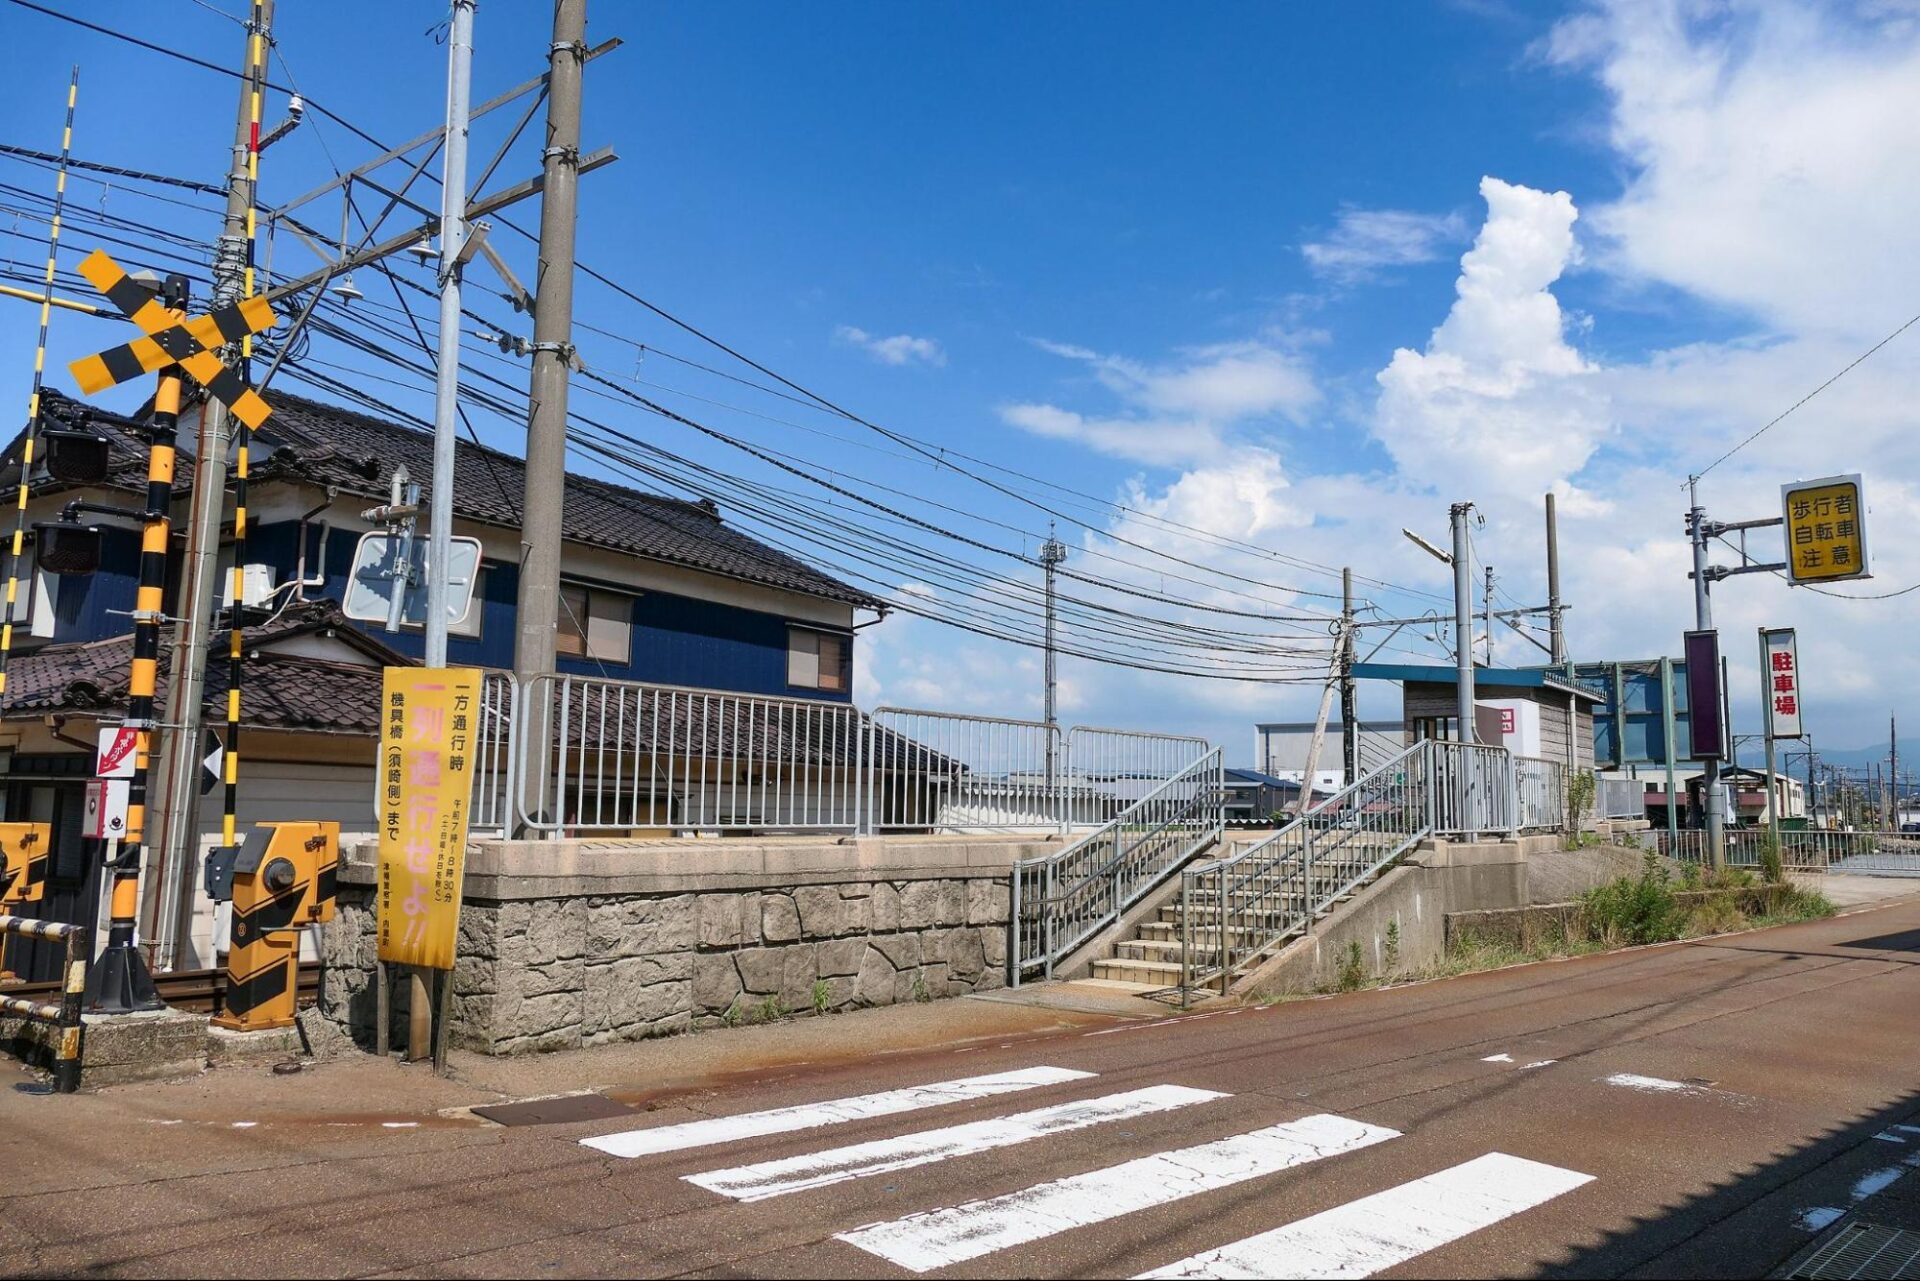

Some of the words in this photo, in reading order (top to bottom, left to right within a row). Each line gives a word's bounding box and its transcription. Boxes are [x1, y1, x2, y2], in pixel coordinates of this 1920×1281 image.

[1793, 495, 1851, 520] 歩行者
[1795, 520, 1855, 545] 自転車
[1800, 545, 1850, 568] 注意
[1772, 652, 1796, 715] 駐車場
[449, 685, 470, 771] 一方通行時
